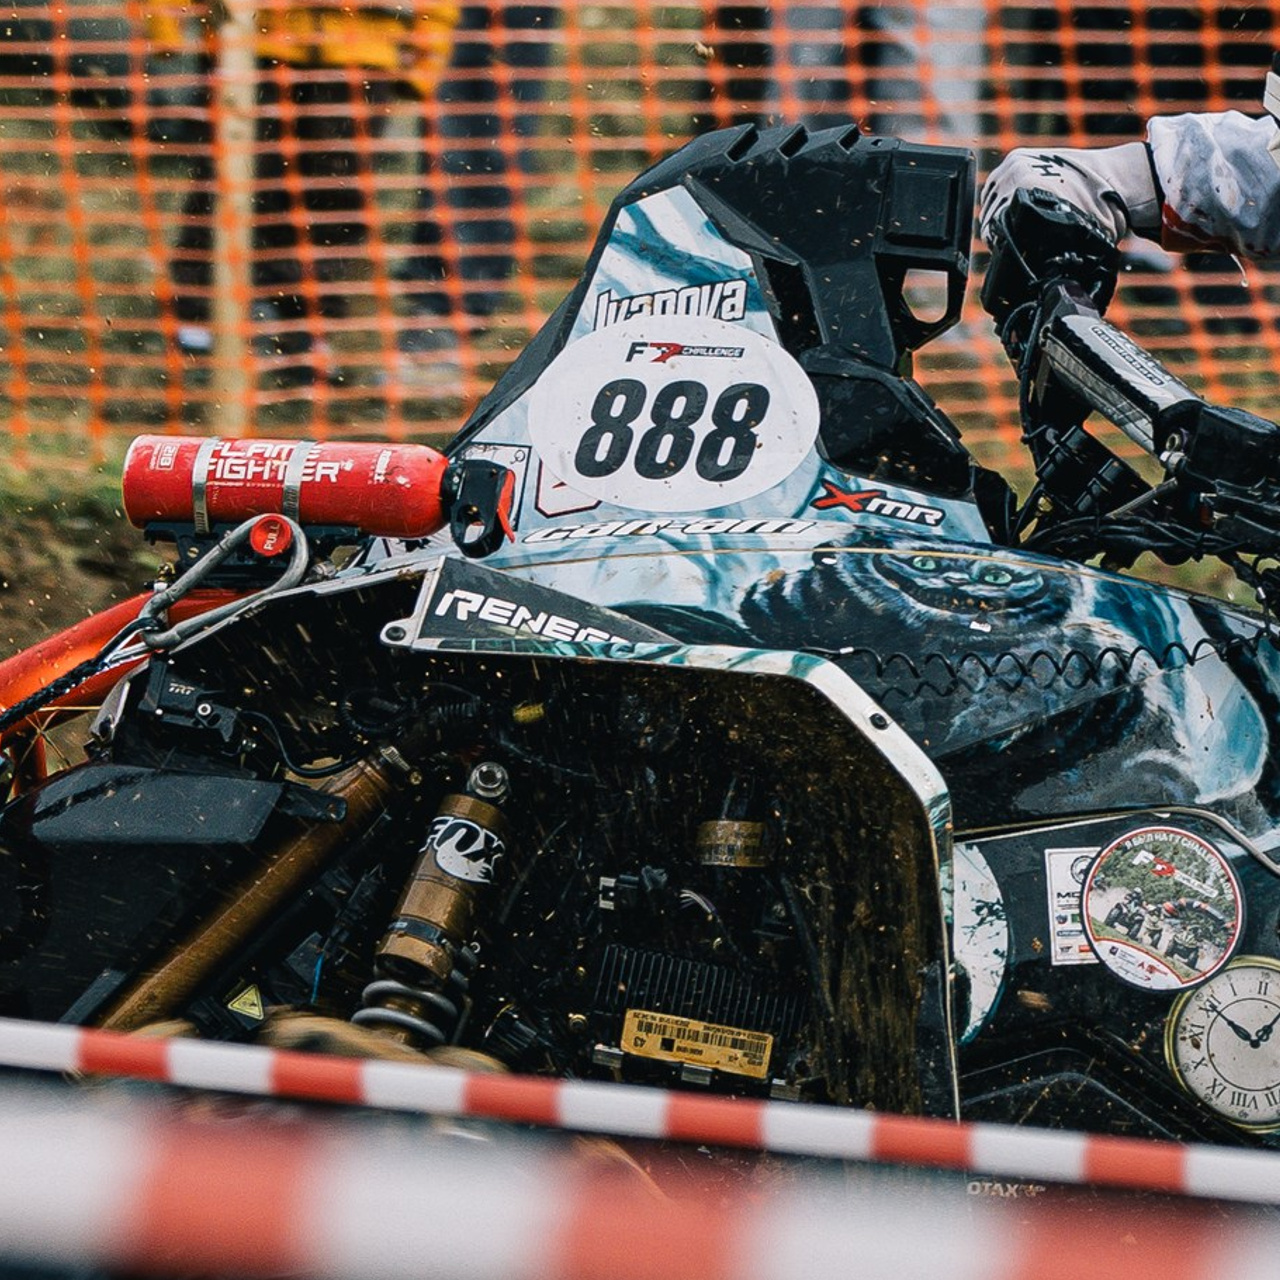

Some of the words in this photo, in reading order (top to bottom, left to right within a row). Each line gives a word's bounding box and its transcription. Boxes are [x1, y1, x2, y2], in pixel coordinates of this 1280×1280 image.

[681, 346, 743, 358] CHALLENGE
[574, 377, 771, 483] 888
[263, 523, 281, 551] PULL
